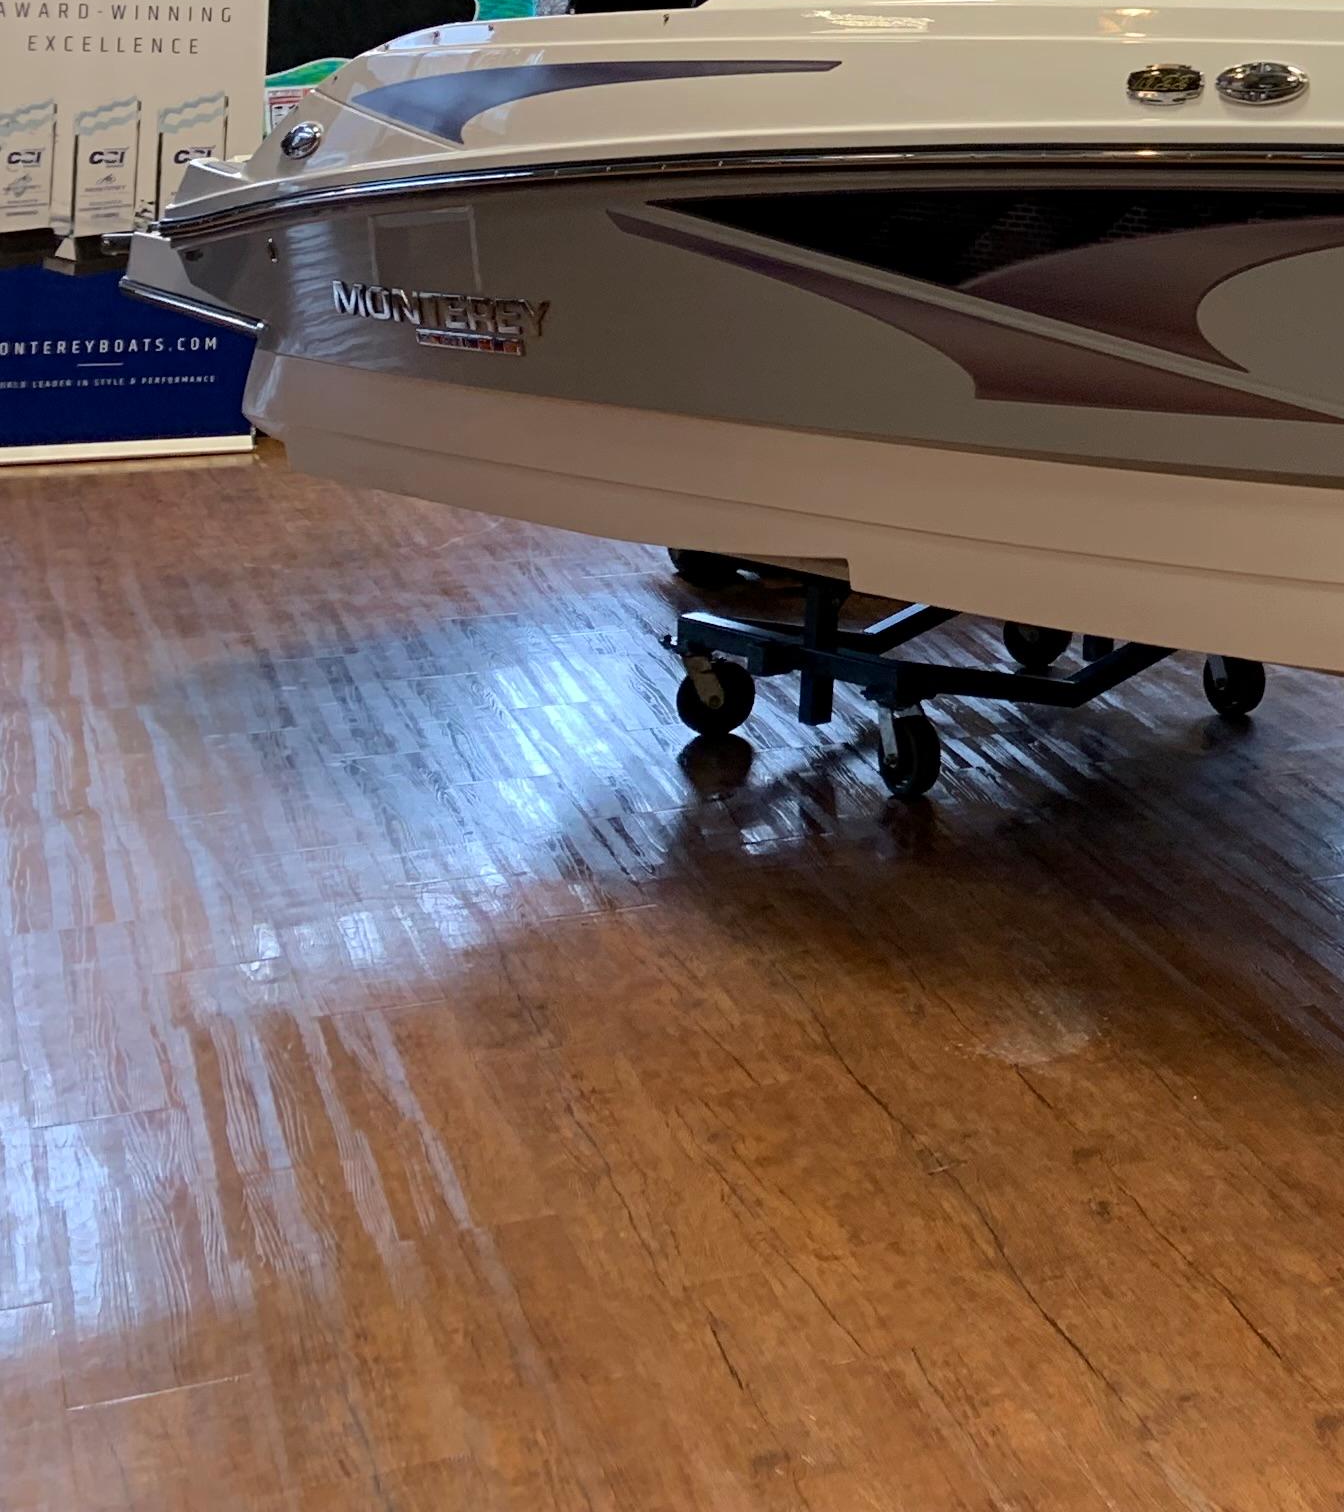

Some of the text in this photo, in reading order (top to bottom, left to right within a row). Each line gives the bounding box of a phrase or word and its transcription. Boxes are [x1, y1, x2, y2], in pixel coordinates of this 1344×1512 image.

[0, 1, 232, 23] AWARD-WINNING
[27, 35, 199, 55] EXCELLENCE
[332, 280, 550, 336] MONTEREY
[94, 377, 125, 386] STYLE
[141, 374, 215, 385] PERFORMANCE
